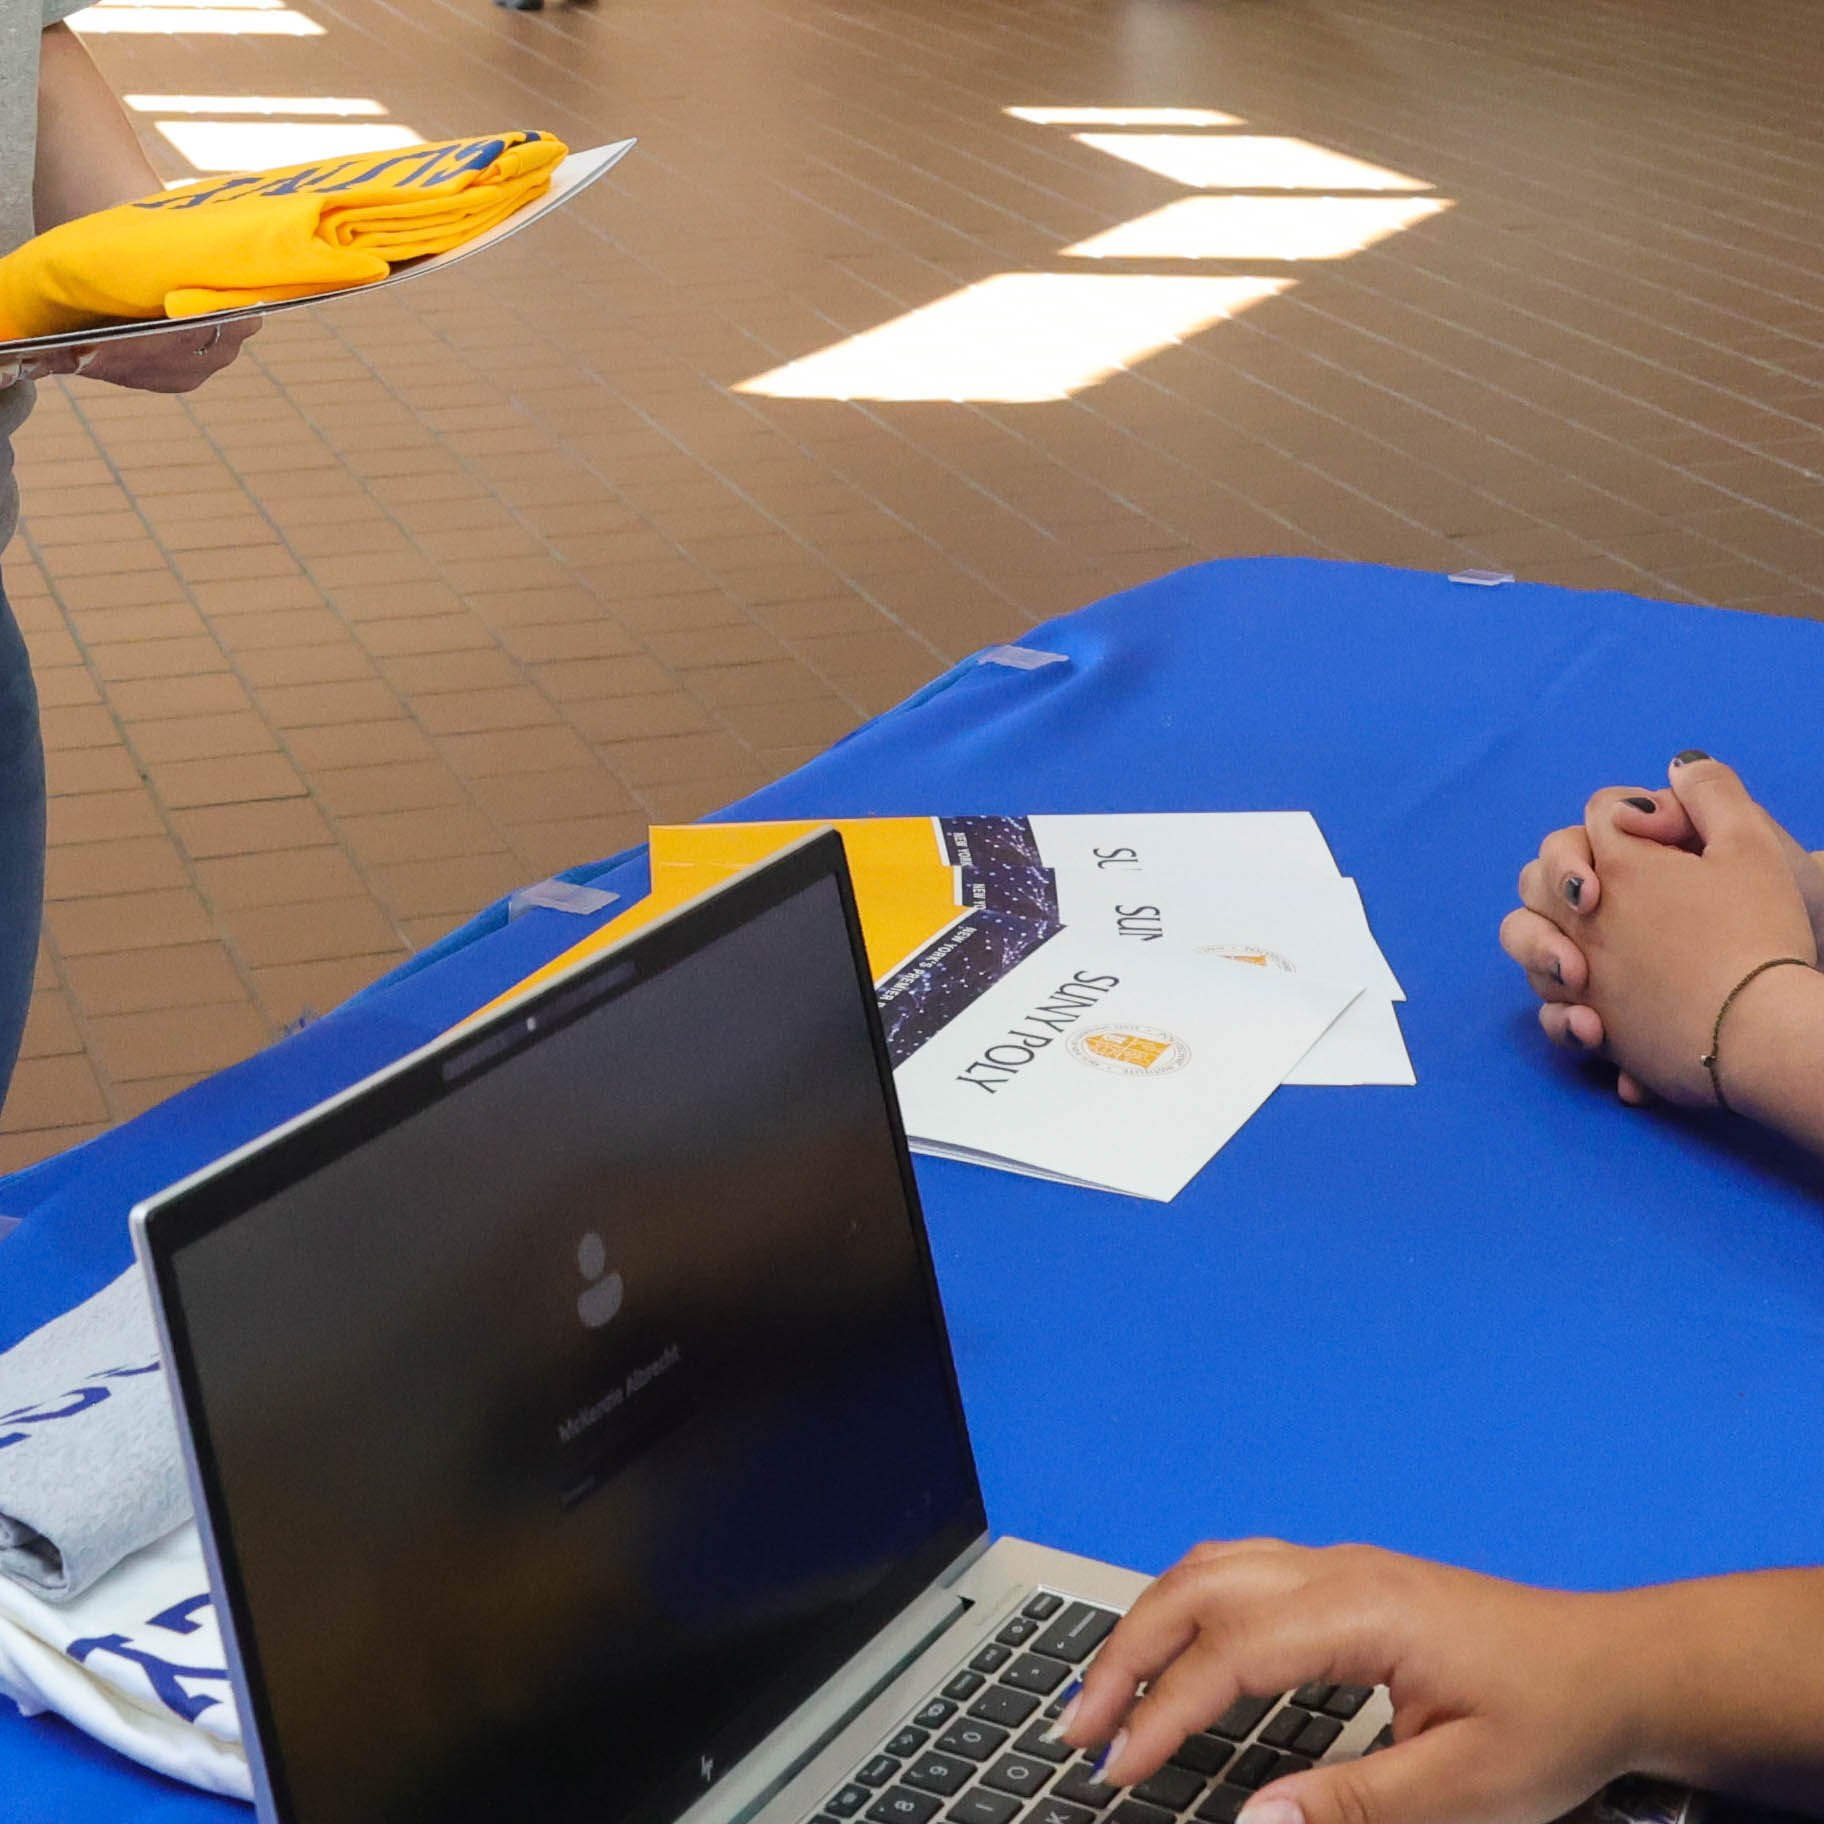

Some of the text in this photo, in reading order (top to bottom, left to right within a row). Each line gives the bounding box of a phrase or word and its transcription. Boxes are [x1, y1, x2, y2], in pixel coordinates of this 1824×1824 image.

[951, 926, 978, 944] NEW
[879, 968, 925, 1001] PREMIER
[1025, 970, 1120, 1033] SUNY
[956, 1030, 1054, 1094] POLY
